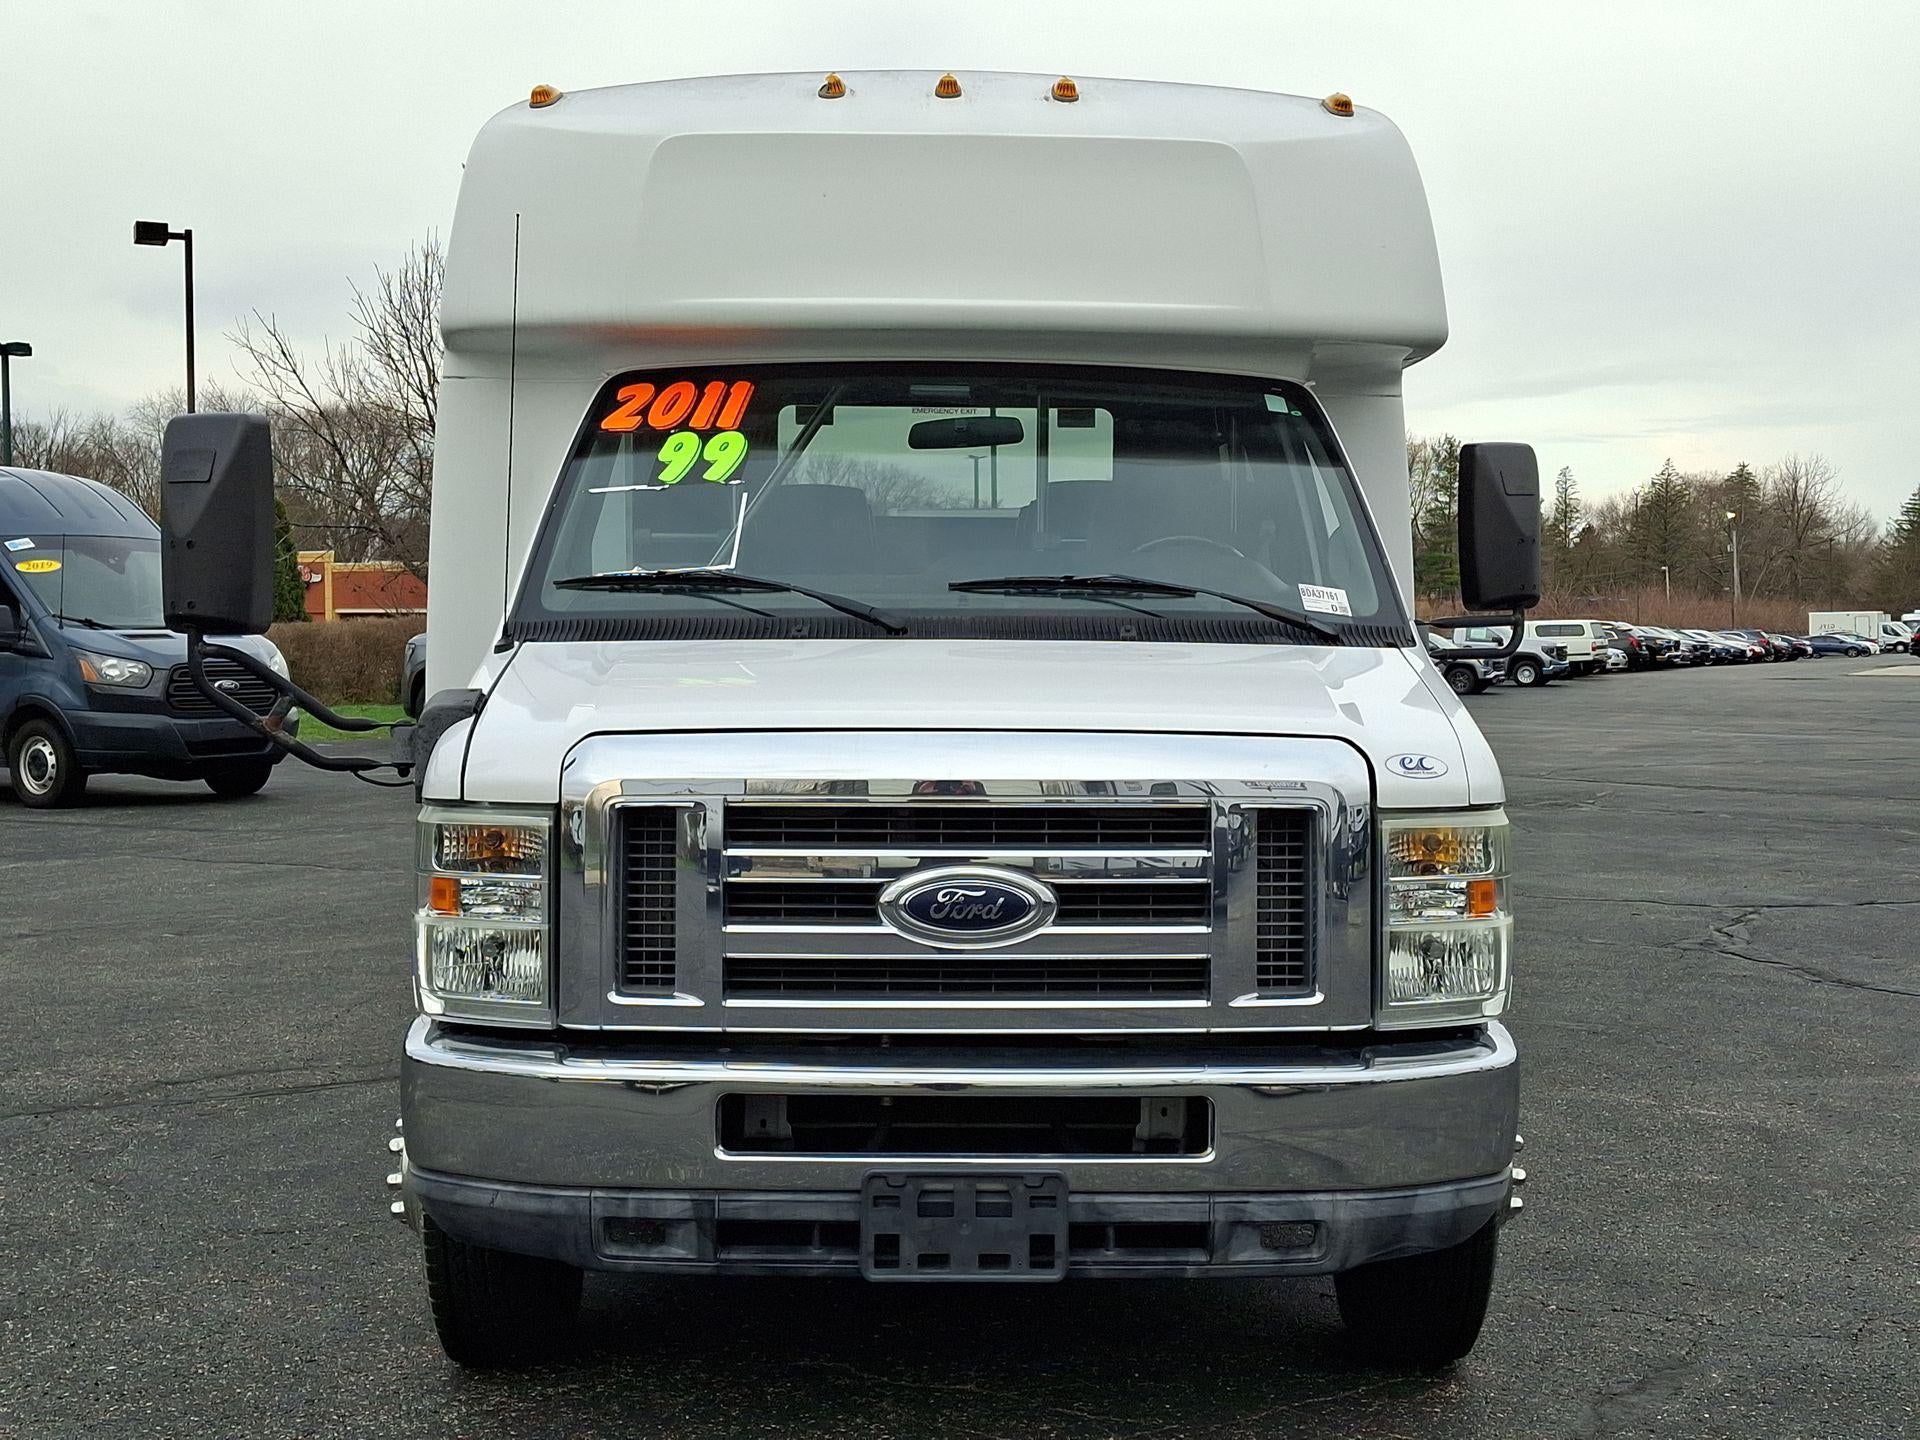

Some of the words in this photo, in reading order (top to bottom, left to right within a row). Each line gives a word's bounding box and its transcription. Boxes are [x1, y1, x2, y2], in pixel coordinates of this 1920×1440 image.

[600, 381, 755, 432] 2011
[911, 407, 959, 415] EMERGENCY
[657, 431, 749, 485] 99
[25, 561, 53, 571] 2019
[929, 888, 1004, 920] Ford
